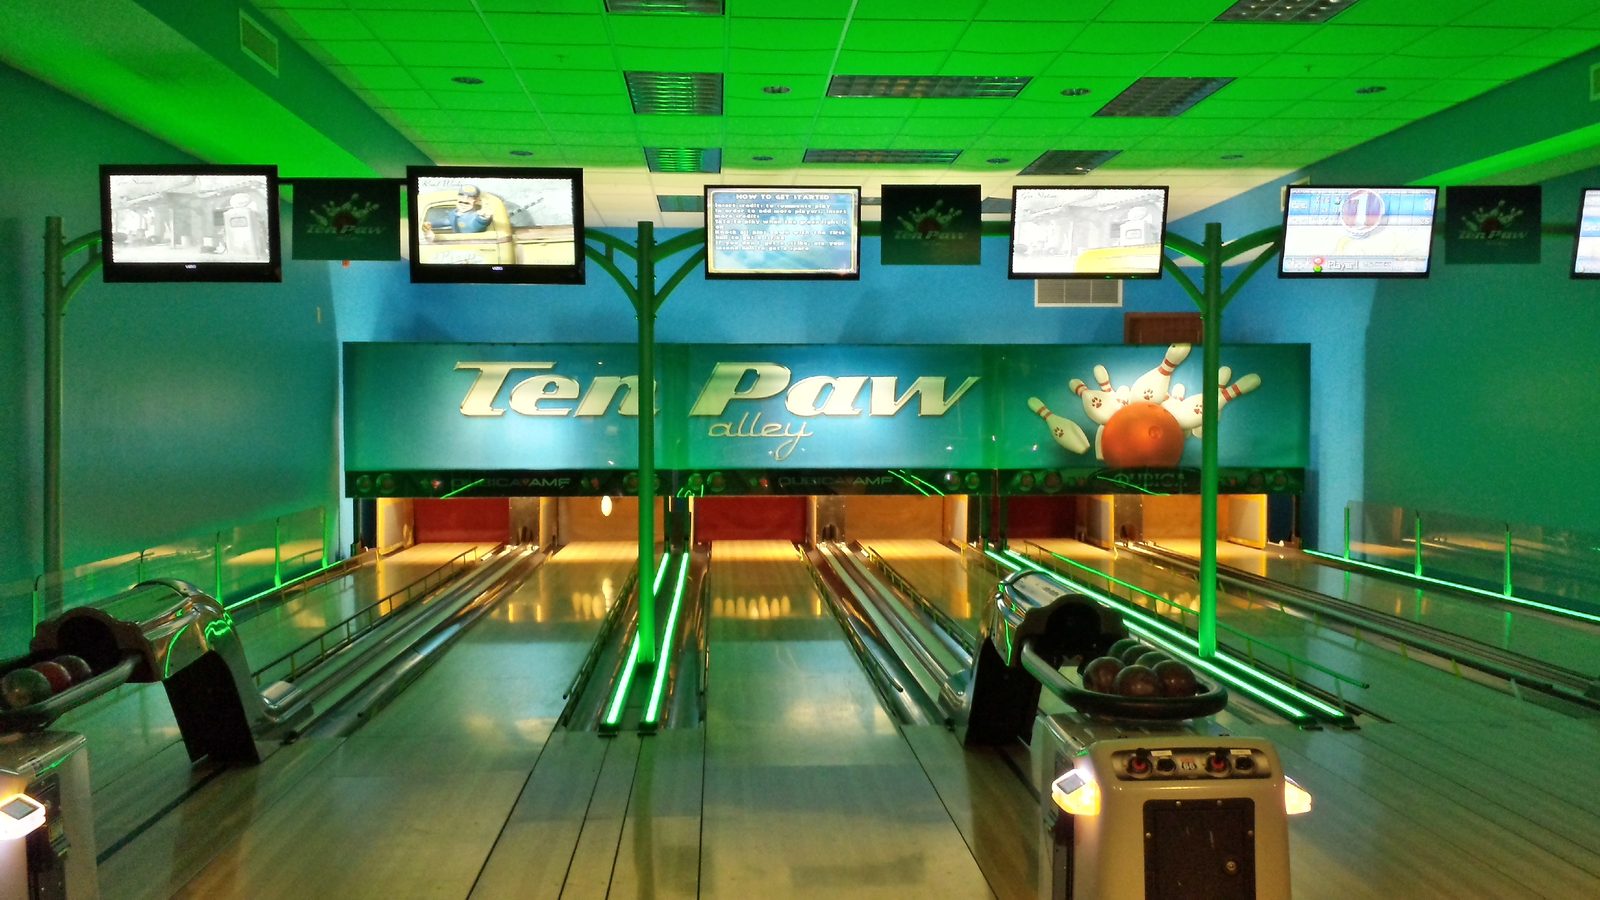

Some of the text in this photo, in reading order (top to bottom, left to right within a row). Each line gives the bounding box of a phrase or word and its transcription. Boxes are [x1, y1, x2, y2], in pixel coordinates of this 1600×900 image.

[454, 361, 982, 417] Ten Paw
[708, 411, 815, 461] alley
